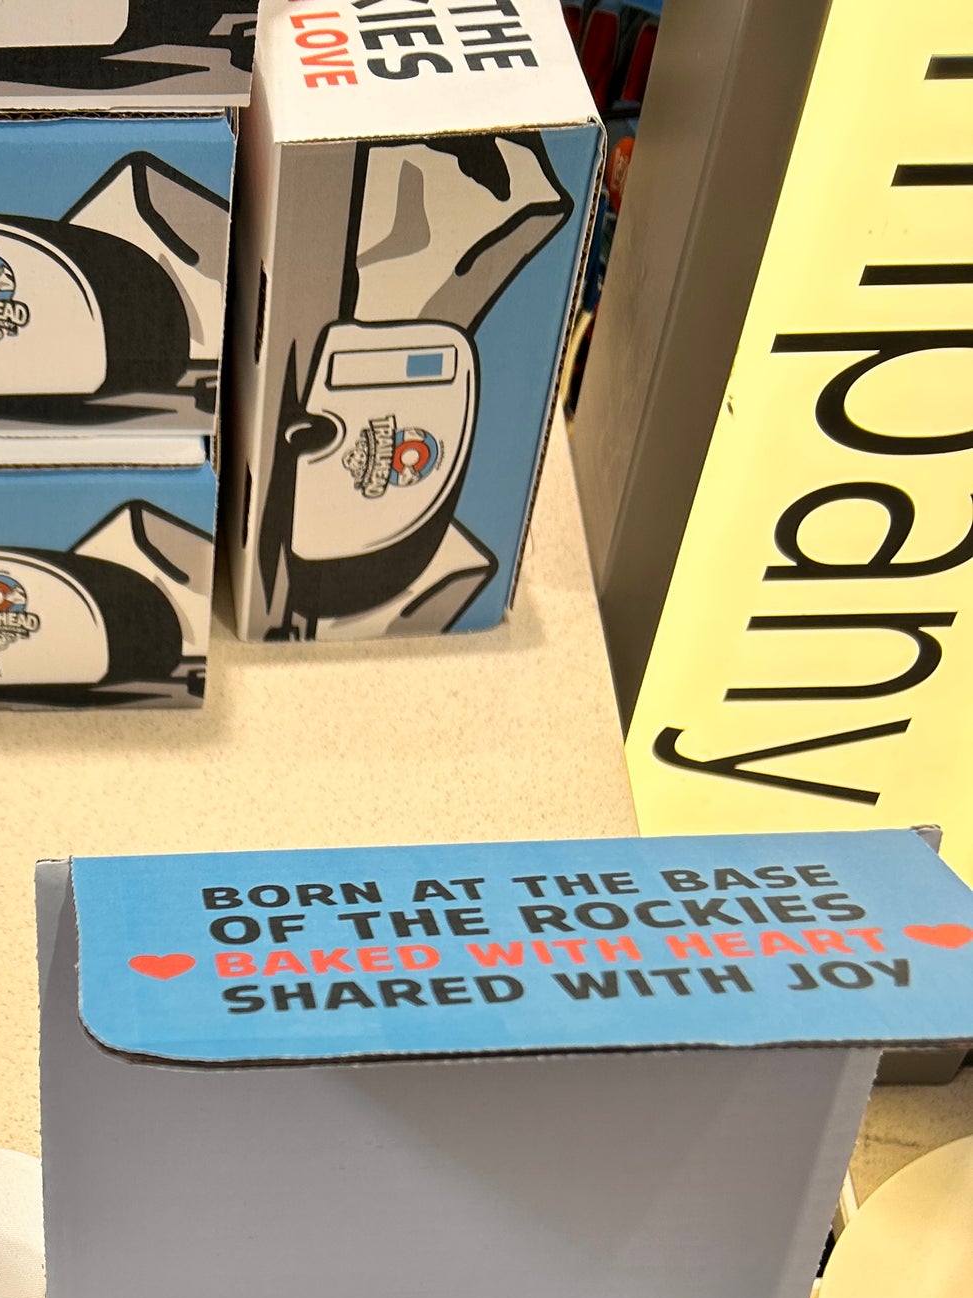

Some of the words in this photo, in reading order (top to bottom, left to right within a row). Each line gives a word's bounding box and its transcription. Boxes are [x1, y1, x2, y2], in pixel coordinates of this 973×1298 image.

[289, 11, 359, 88] LOVE
[368, 415, 394, 497] TRAILHEAD
[202, 881, 383, 910] BORN
[412, 878, 486, 902] AT
[512, 872, 640, 898] THE
[660, 864, 839, 892] BASE
[209, 914, 306, 945] OF
[337, 907, 490, 940] THE
[518, 893, 866, 934] ROCKIES
[214, 944, 440, 978] BAKED
[465, 936, 643, 967] WITH
[665, 927, 887, 959] HEART
[221, 974, 525, 1015] SHARED
[552, 965, 755, 1000] WITH
[787, 958, 910, 990] JOY
